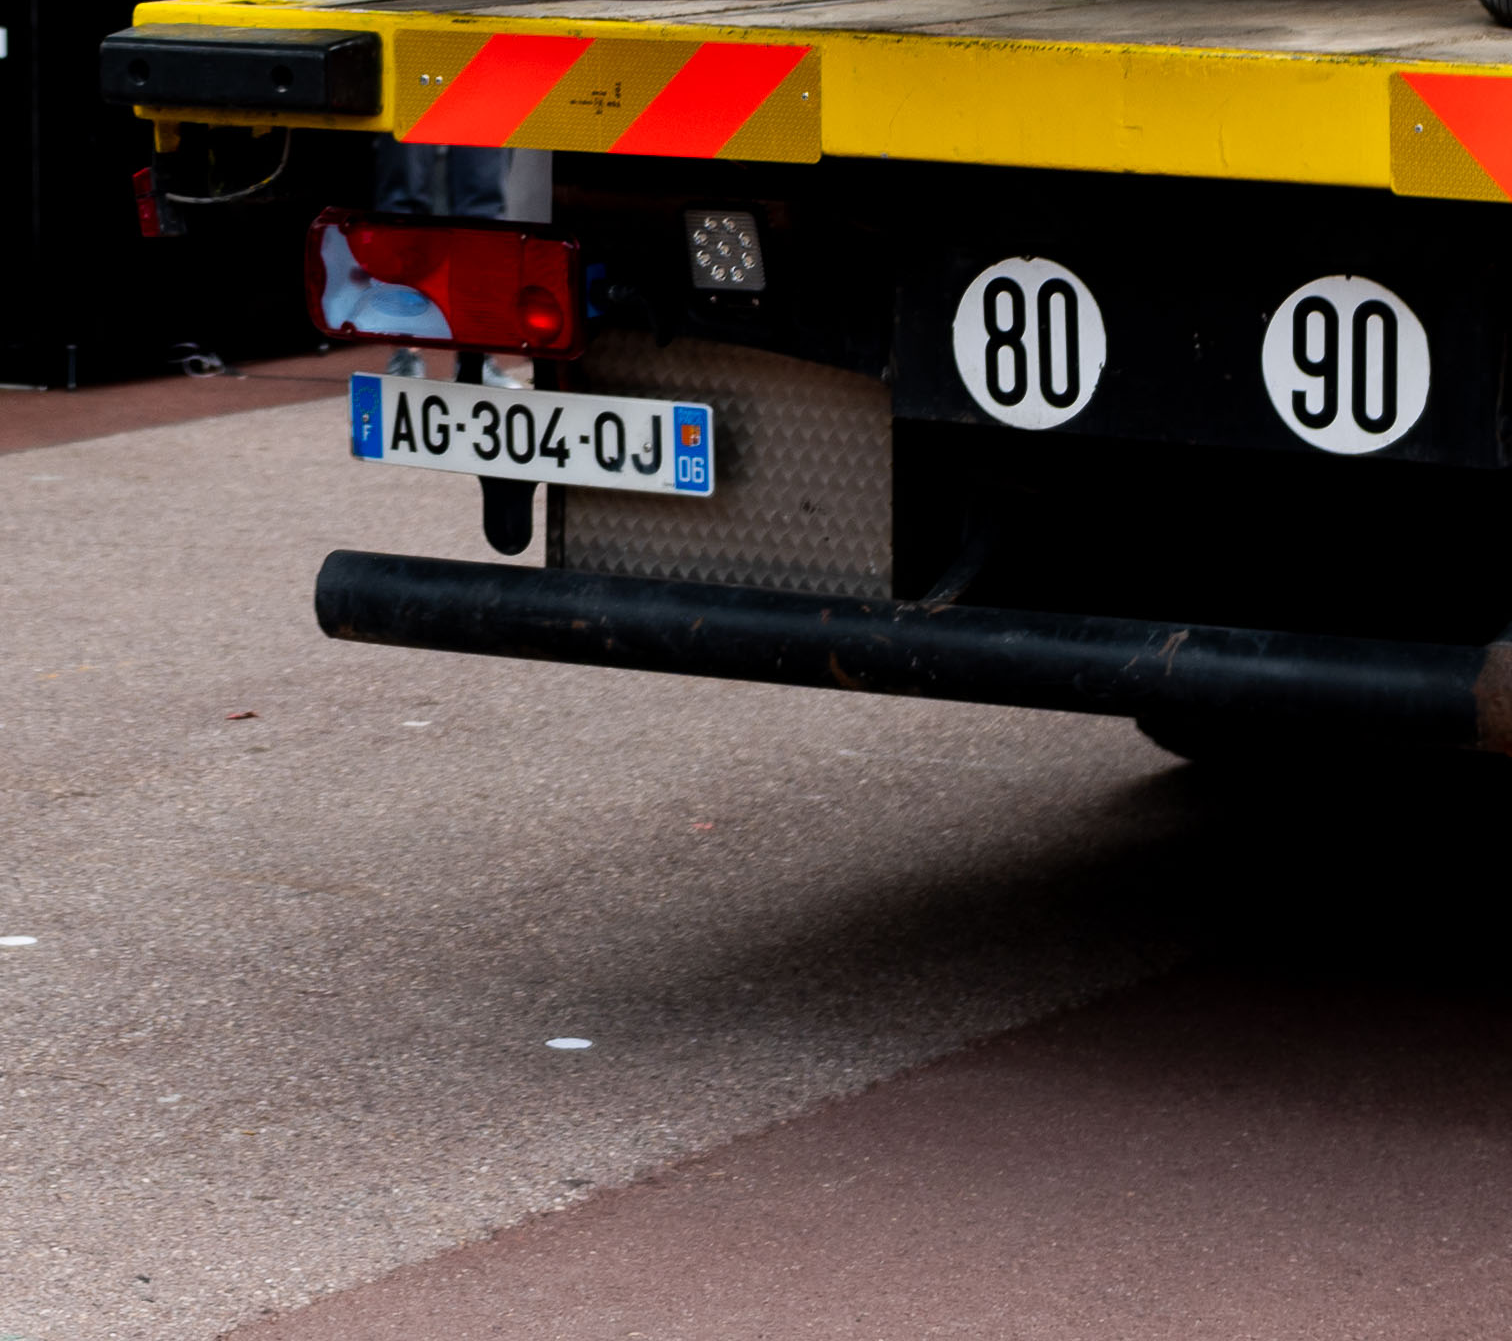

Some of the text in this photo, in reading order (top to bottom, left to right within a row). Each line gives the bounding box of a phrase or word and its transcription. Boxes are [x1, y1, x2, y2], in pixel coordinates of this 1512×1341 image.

[983, 275, 1399, 434] 80 90
[390, 391, 663, 476] AG-304-QJ
[678, 455, 705, 484] 06
